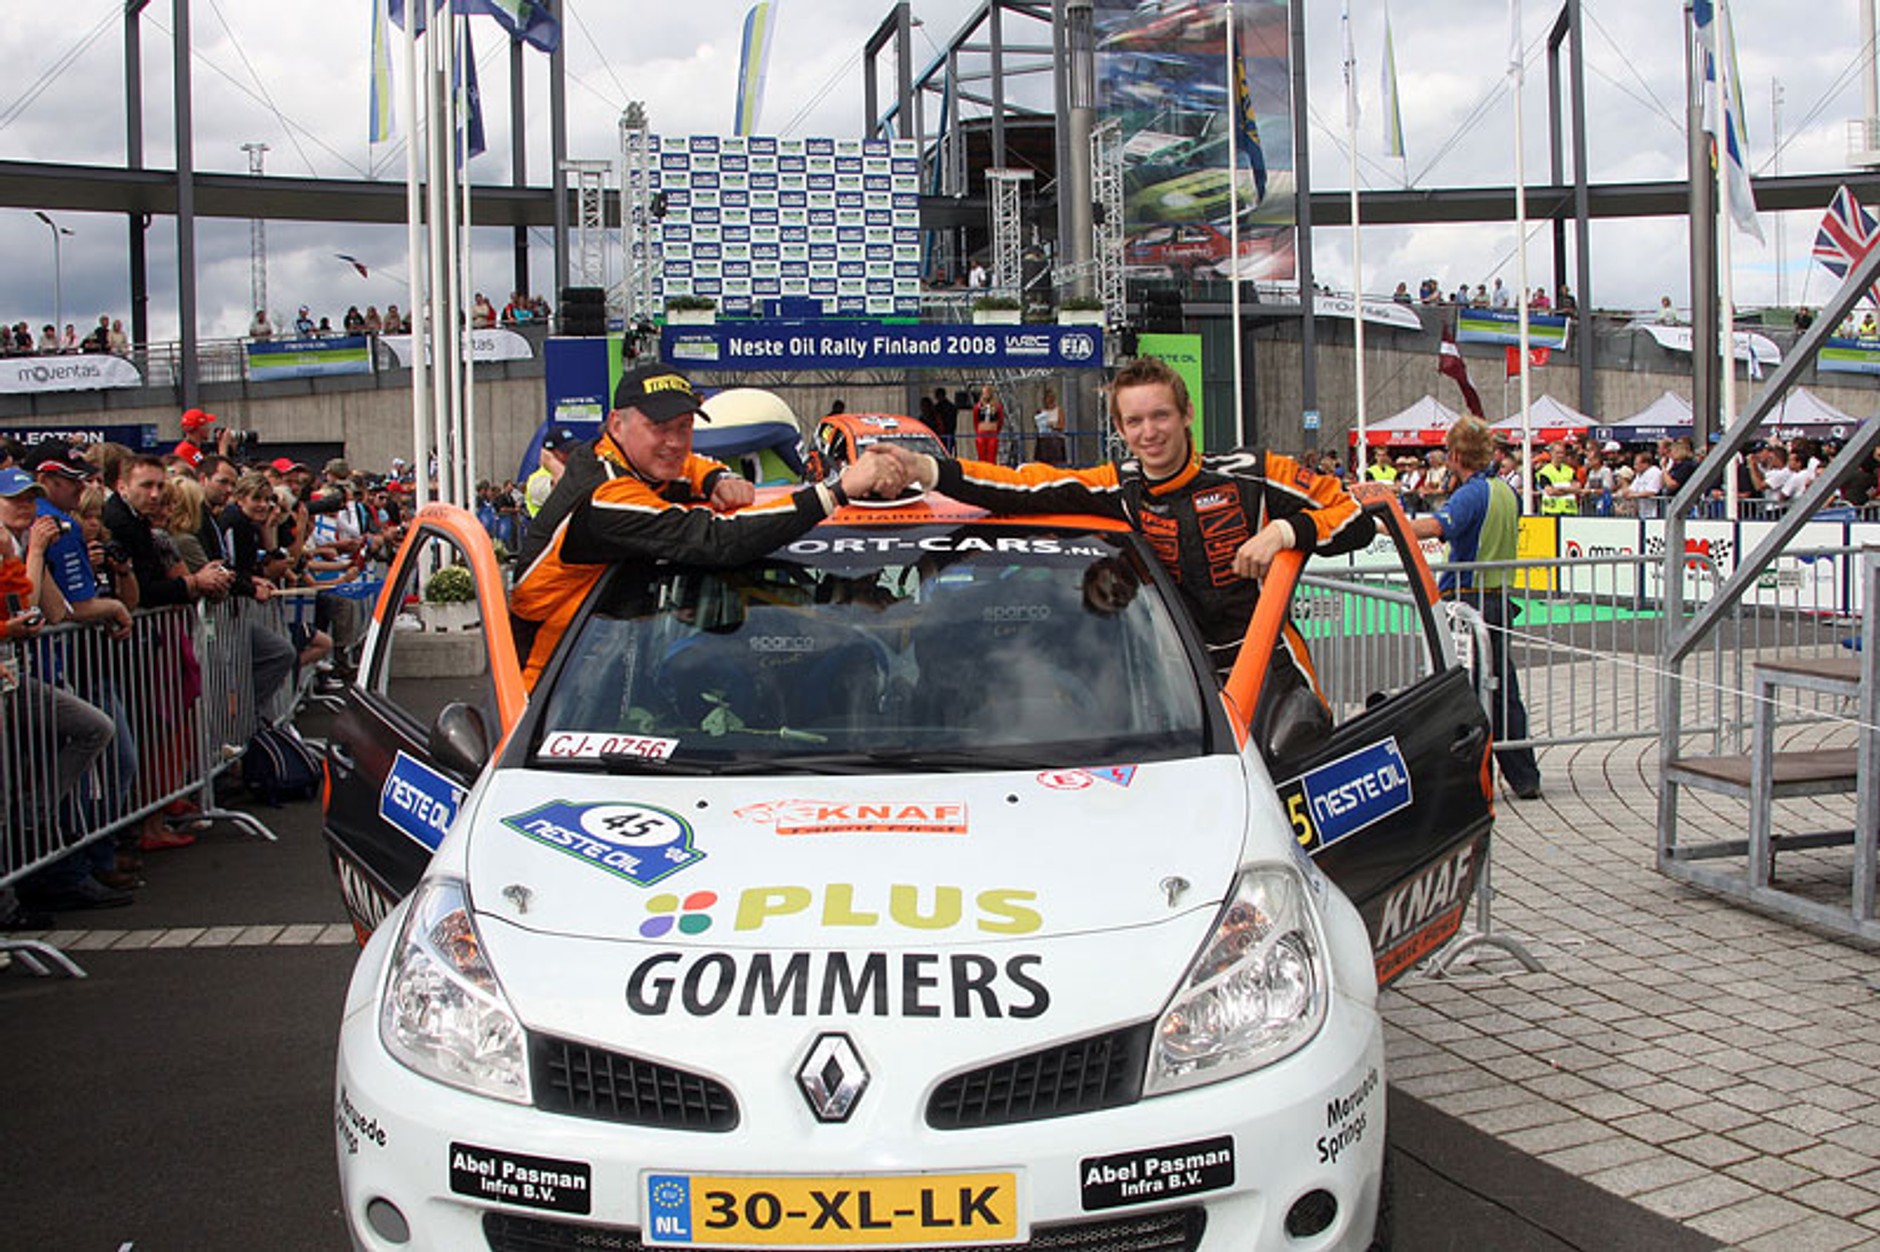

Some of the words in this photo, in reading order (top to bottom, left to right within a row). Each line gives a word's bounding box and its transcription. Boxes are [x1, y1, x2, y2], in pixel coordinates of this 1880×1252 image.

[729, 338, 784, 356] Neste
[789, 338, 816, 356] Oil
[820, 338, 868, 358] Rally
[873, 336, 941, 355] Finland
[947, 336, 996, 354] 2008
[1060, 337, 1090, 354] FIA
[785, 537, 1108, 556] ORT-CARS.NL
[384, 776, 433, 823] NESTE
[1314, 773, 1380, 823] NESTE
[1377, 763, 1406, 791] OIL
[602, 813, 664, 838] 45
[818, 805, 961, 821] KNAF
[1287, 793, 1313, 846] 5
[523, 819, 613, 858] NESTE
[602, 850, 642, 876] OIL
[733, 882, 1044, 935] PLUS
[1376, 844, 1473, 949] KNAF
[624, 951, 1052, 1019] GOMMERS
[1317, 1112, 1367, 1164] Springs
[453, 1152, 496, 1177] Abel
[502, 1162, 587, 1190] Pasman
[1085, 1161, 1137, 1186] Abel
[1145, 1149, 1231, 1177] Pasman
[1121, 1177, 1164, 1197] Infra
[1168, 1172, 1202, 1189] B.V.
[481, 1178, 519, 1196] Infra
[523, 1184, 556, 1202] B.V.
[704, 1185, 1002, 1230] 30-XL-LK
[656, 1216, 688, 1235] NL
